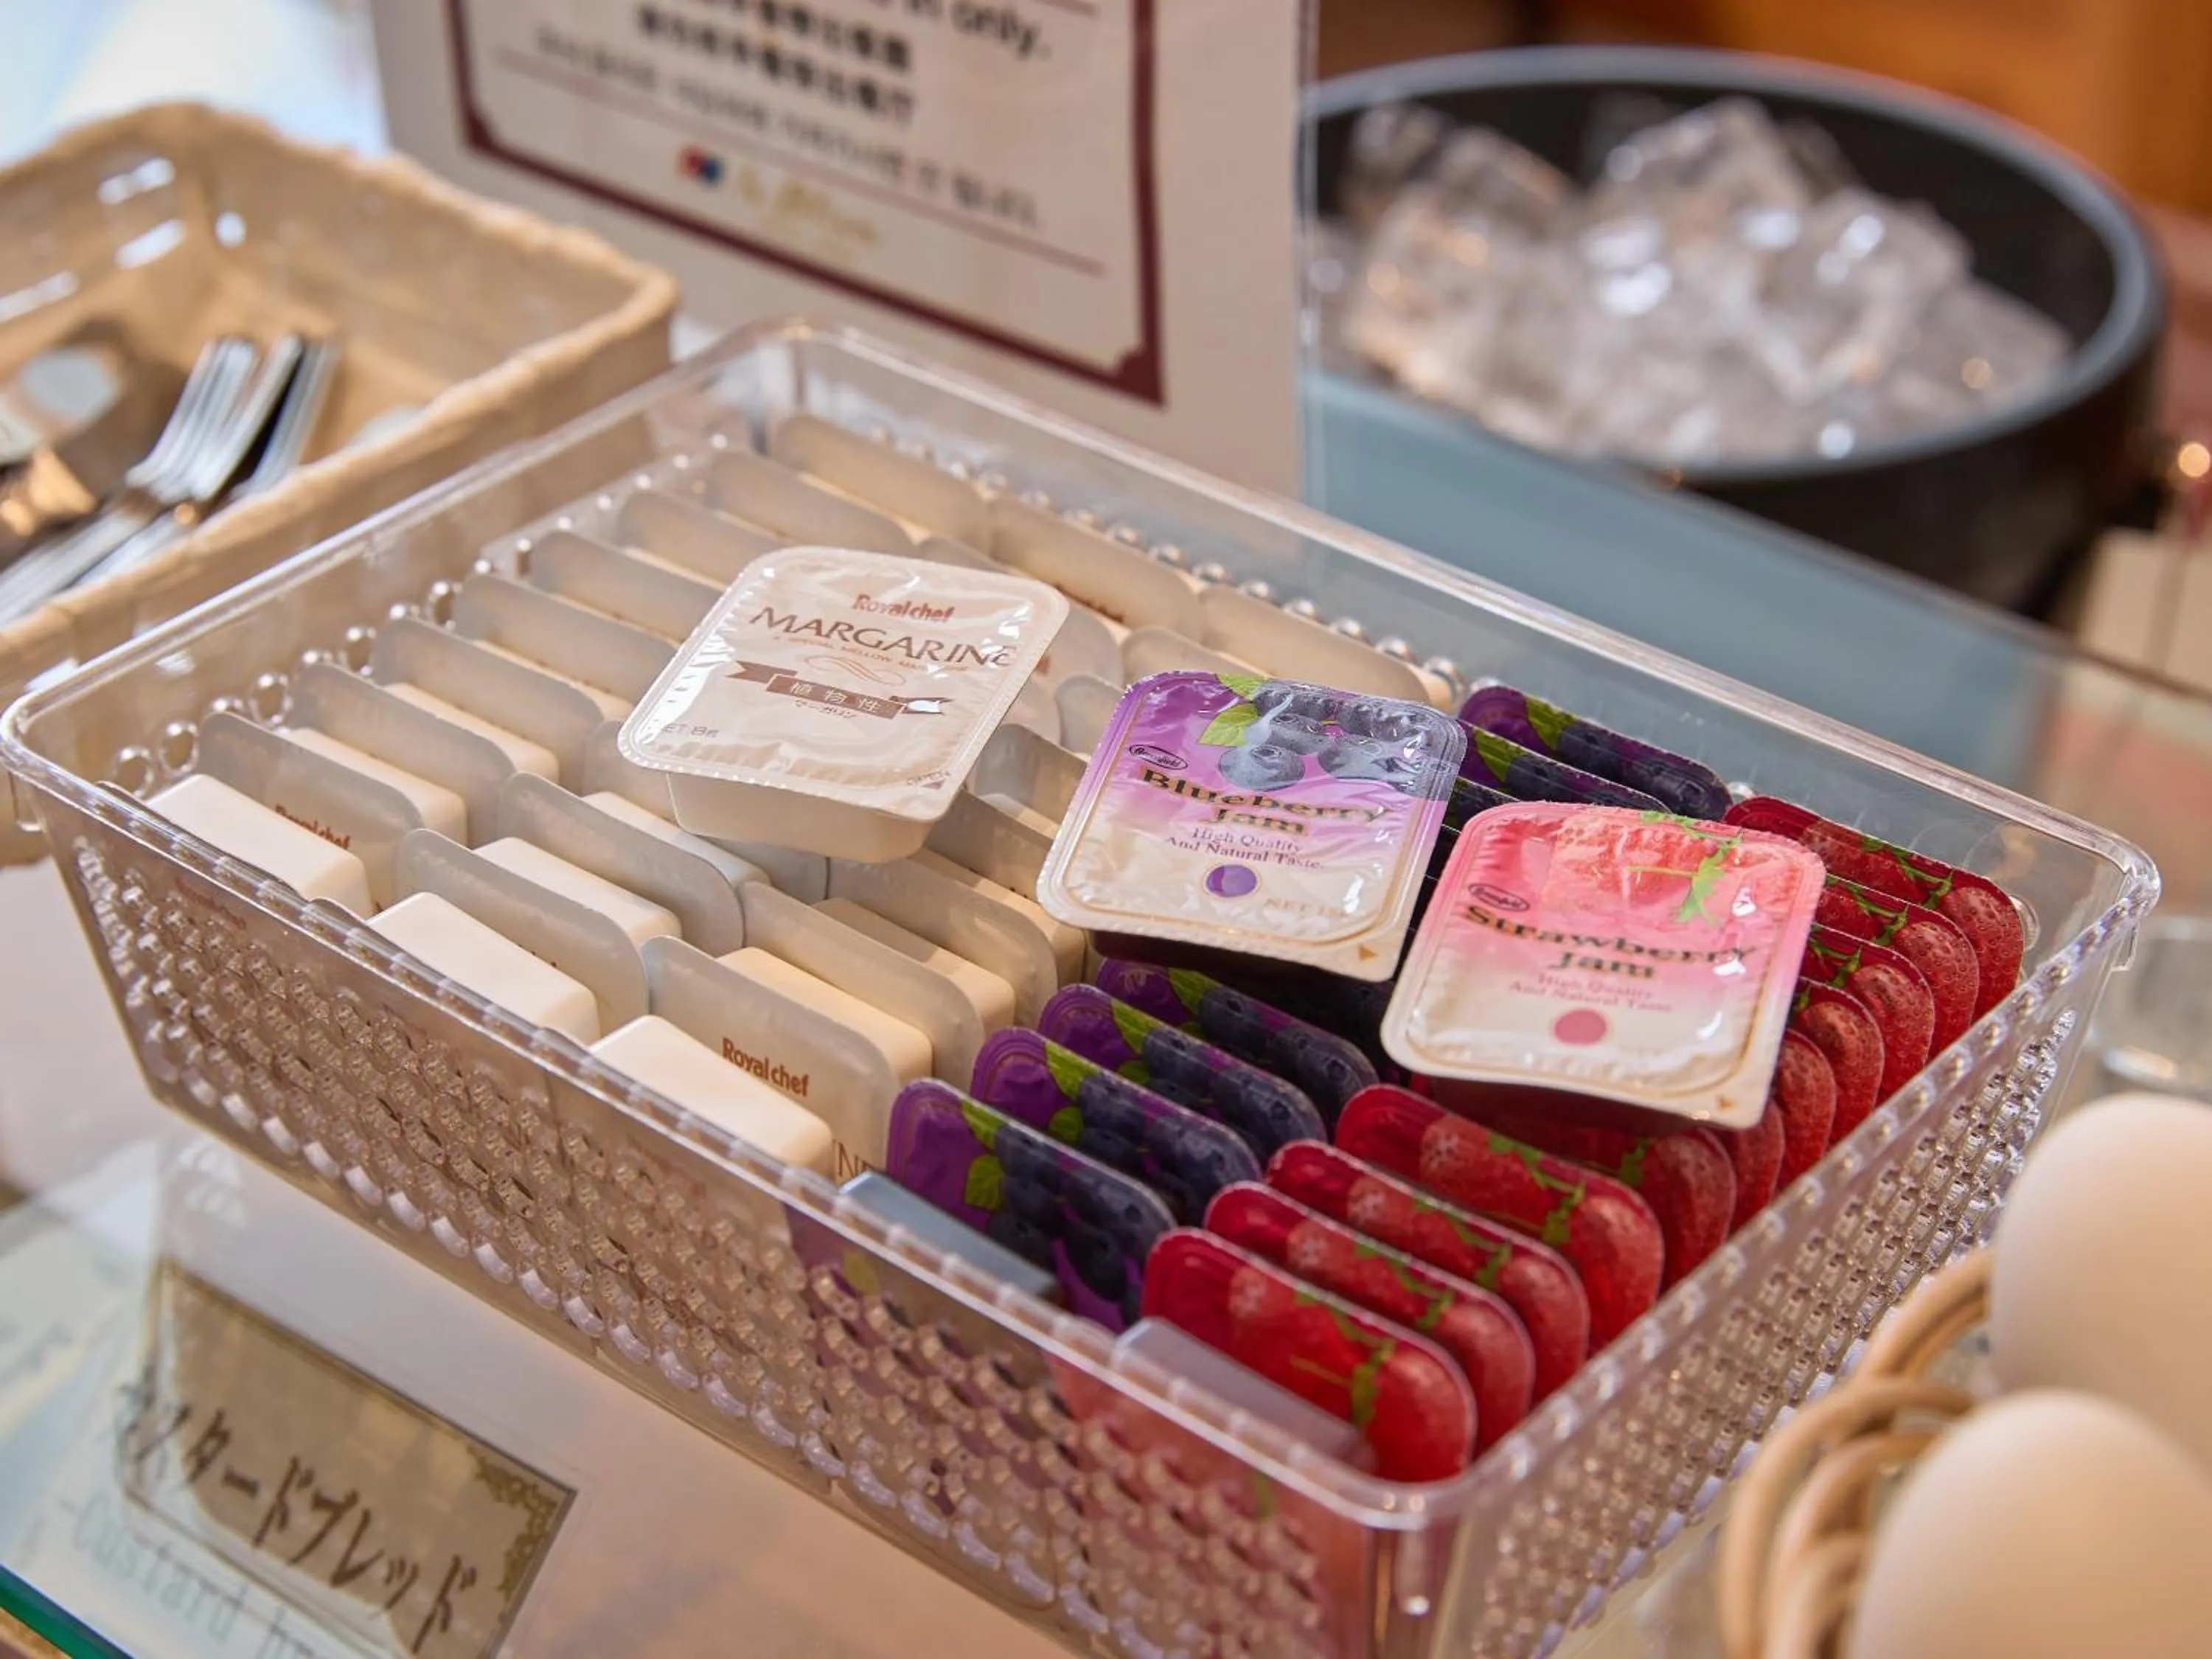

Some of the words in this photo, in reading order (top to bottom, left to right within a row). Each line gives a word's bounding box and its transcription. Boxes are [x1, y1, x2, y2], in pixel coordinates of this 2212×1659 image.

[1142, 768, 1391, 822] Blueberry
[1205, 808, 1307, 835] Jam
[1165, 836, 1202, 852] And
[1206, 843, 1270, 863] Natural
[1192, 827, 1235, 845] High
[1465, 905, 1757, 964] Strawberry
[1549, 952, 1656, 978] Jam
